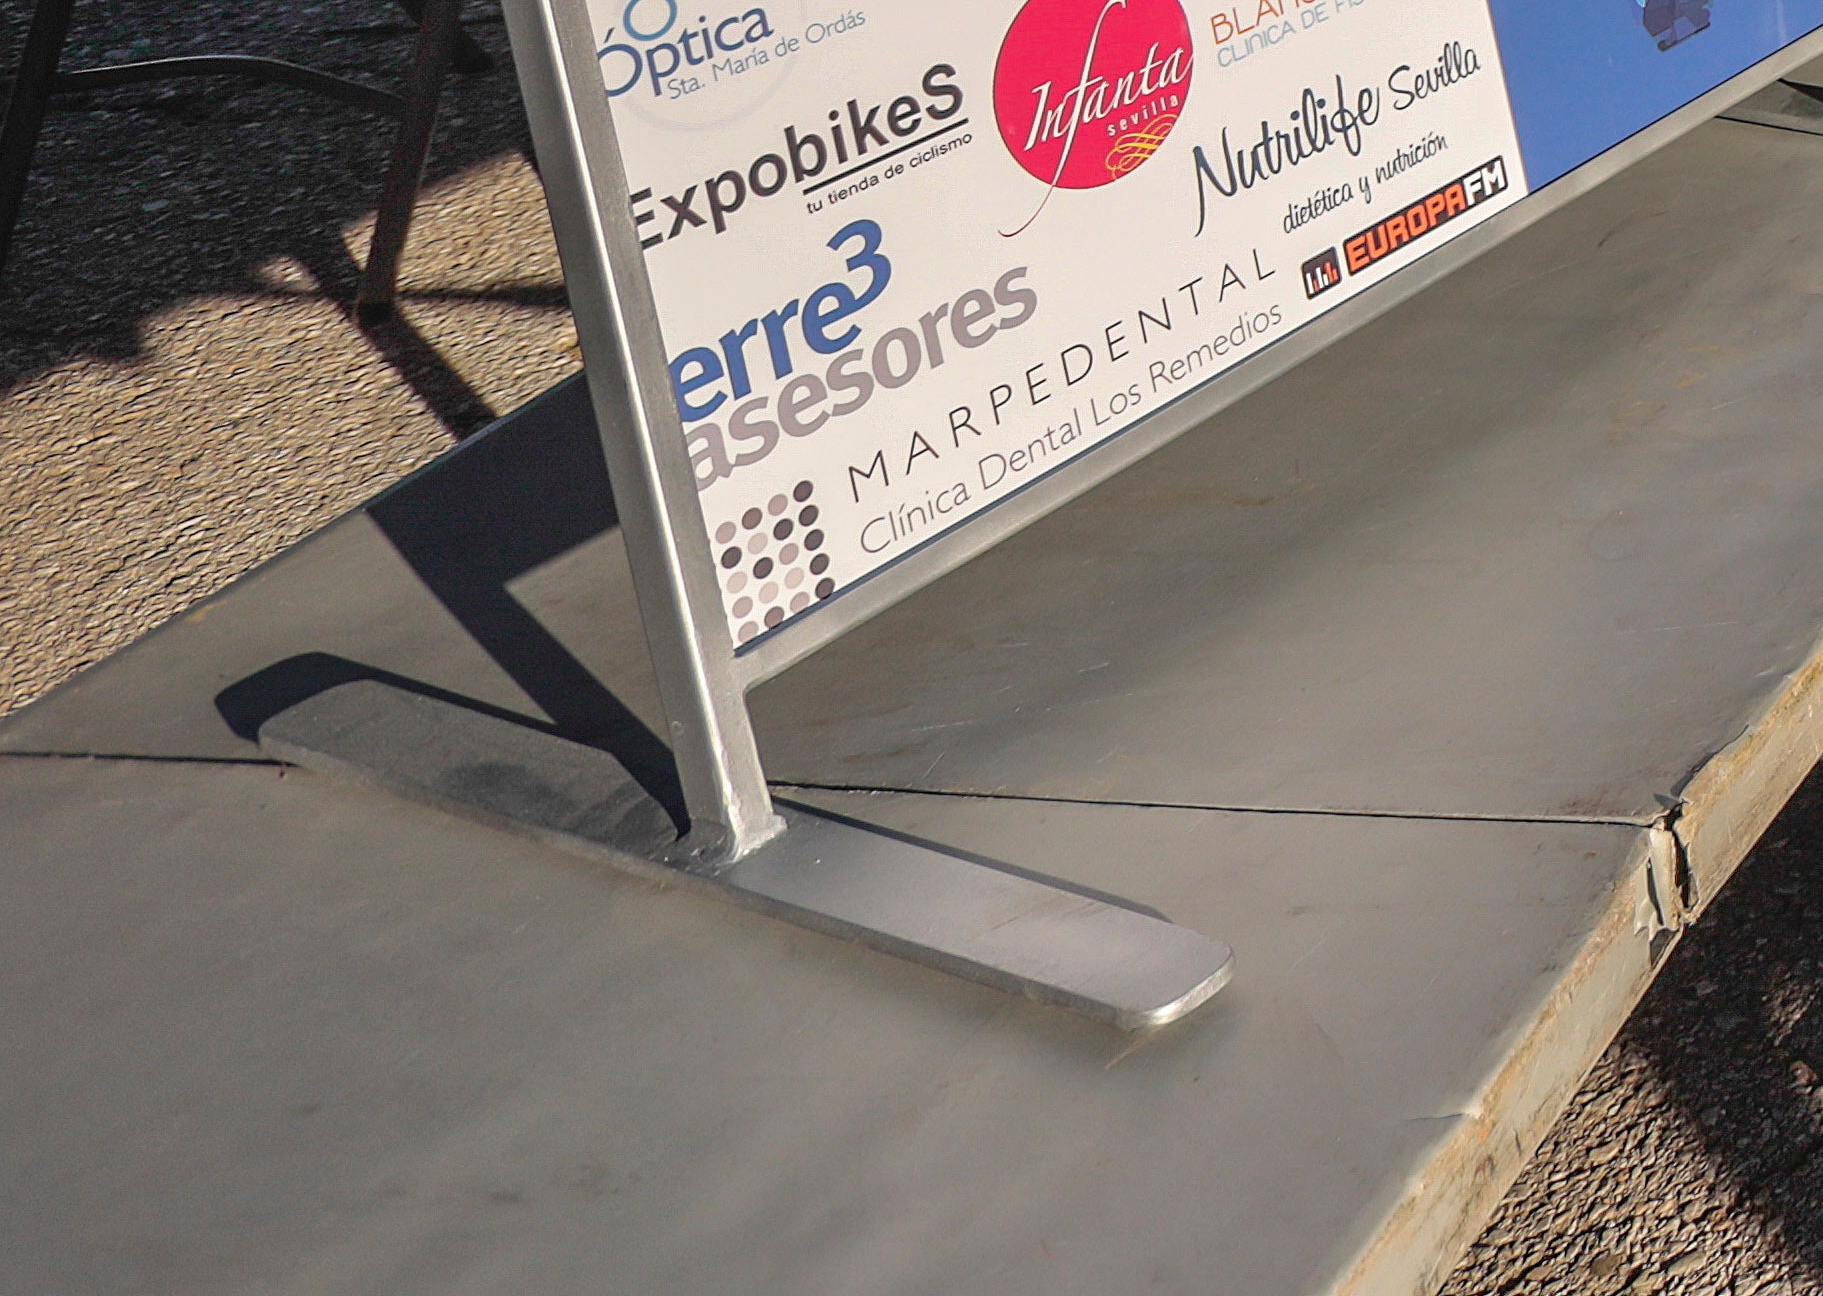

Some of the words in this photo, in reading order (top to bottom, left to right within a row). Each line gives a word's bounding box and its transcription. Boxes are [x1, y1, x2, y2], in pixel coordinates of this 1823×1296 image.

[596, 6, 774, 99] Óptica
[666, 75, 707, 102] Sta.
[711, 47, 771, 85] María
[774, 33, 801, 58] de
[804, 8, 867, 45] Ordás
[1216, 19, 1297, 70] CLINICA
[1300, 6, 1329, 31] DE
[1106, 92, 1180, 138] sevilla
[1192, 73, 1381, 238] Nutrilife
[1387, 39, 1482, 111] Sevilla
[806, 198, 825, 216] tu
[827, 173, 880, 206] tienda
[883, 159, 906, 183] de
[908, 132, 974, 169] ciclismo
[1282, 180, 1355, 234] dietética
[1359, 175, 1374, 204] y
[1375, 130, 1450, 183] nutrición
[682, 265, 1039, 493] asesores
[847, 247, 1277, 505] MARPEDENTAL
[859, 482, 973, 556] Clínica
[977, 414, 1083, 493] Dental
[1093, 380, 1143, 428] Los
[1146, 302, 1283, 389] Remedios
